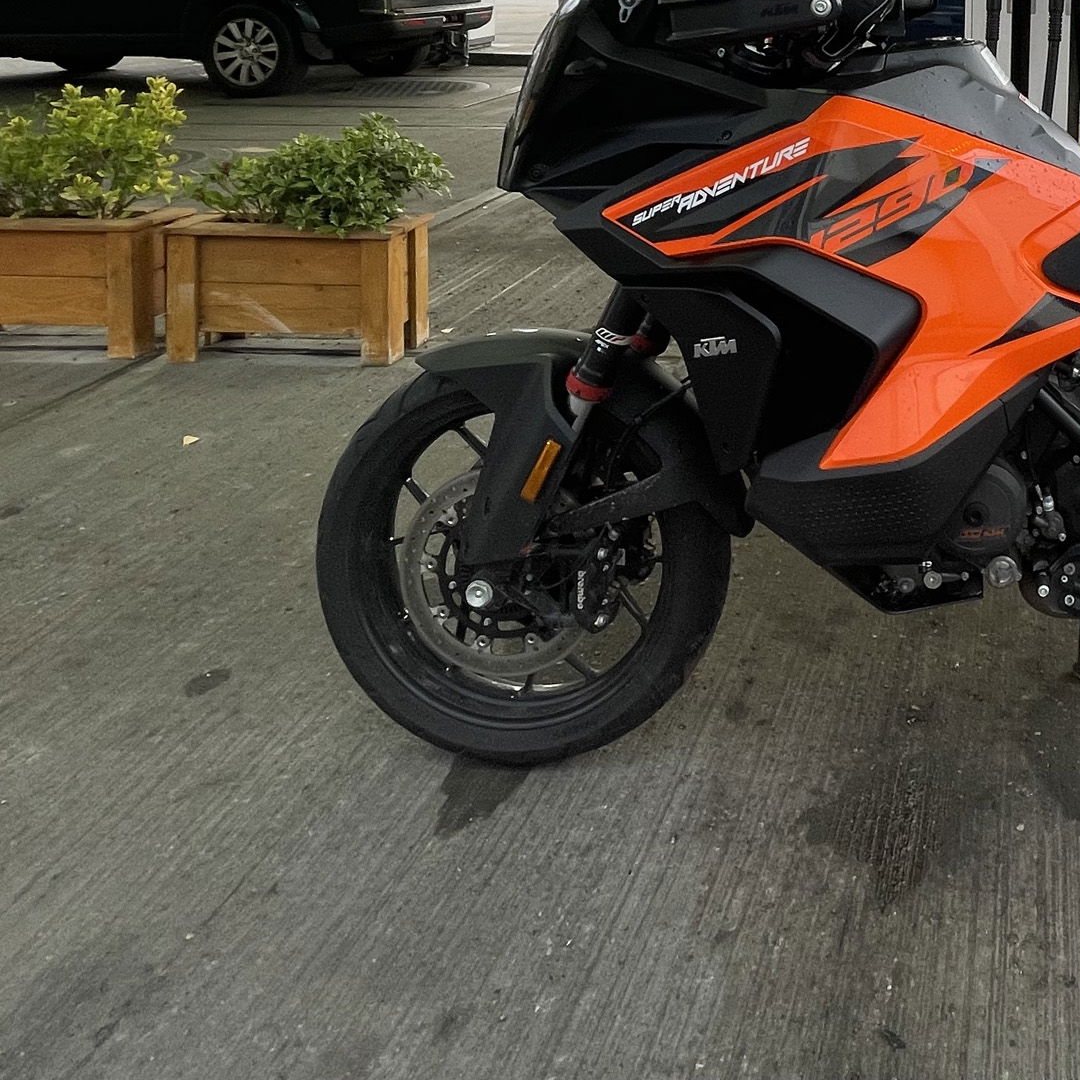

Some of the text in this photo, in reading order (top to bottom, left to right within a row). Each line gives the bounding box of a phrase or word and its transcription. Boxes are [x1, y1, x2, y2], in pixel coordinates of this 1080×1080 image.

[632, 137, 811, 226] SUPER ADVENTURE
[809, 155, 976, 254] 1290
[693, 336, 738, 358] KTM
[577, 570, 587, 610] brembo
